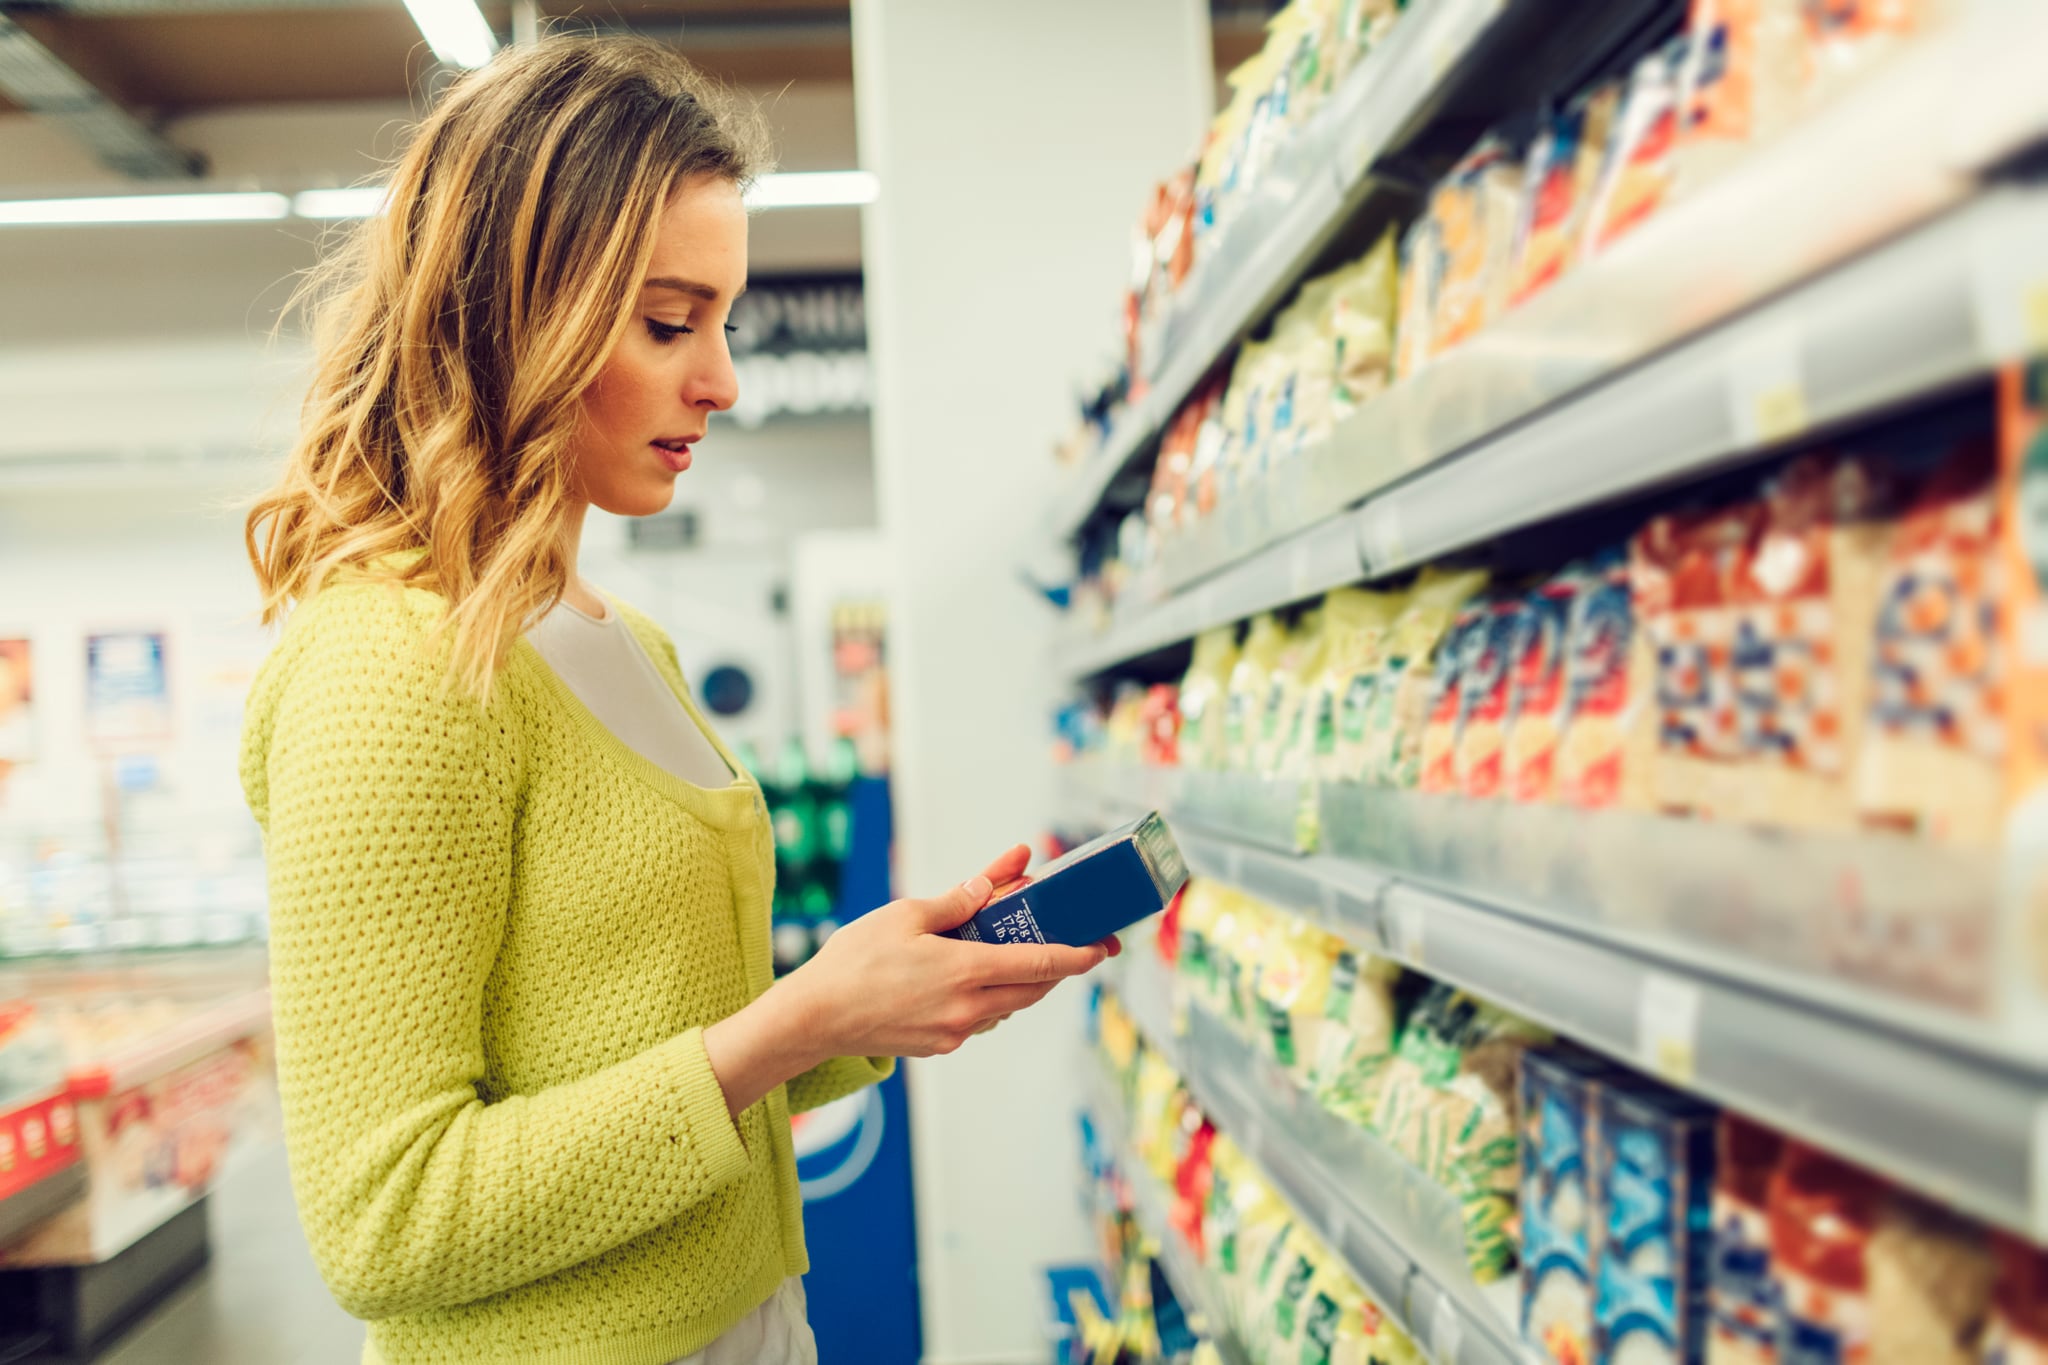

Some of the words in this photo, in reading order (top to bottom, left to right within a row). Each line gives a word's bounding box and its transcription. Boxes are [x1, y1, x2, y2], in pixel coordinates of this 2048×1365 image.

[1002, 914, 1020, 935] 17.6
[1012, 910, 1028, 929] 500
[1019, 929, 1031, 938] g
